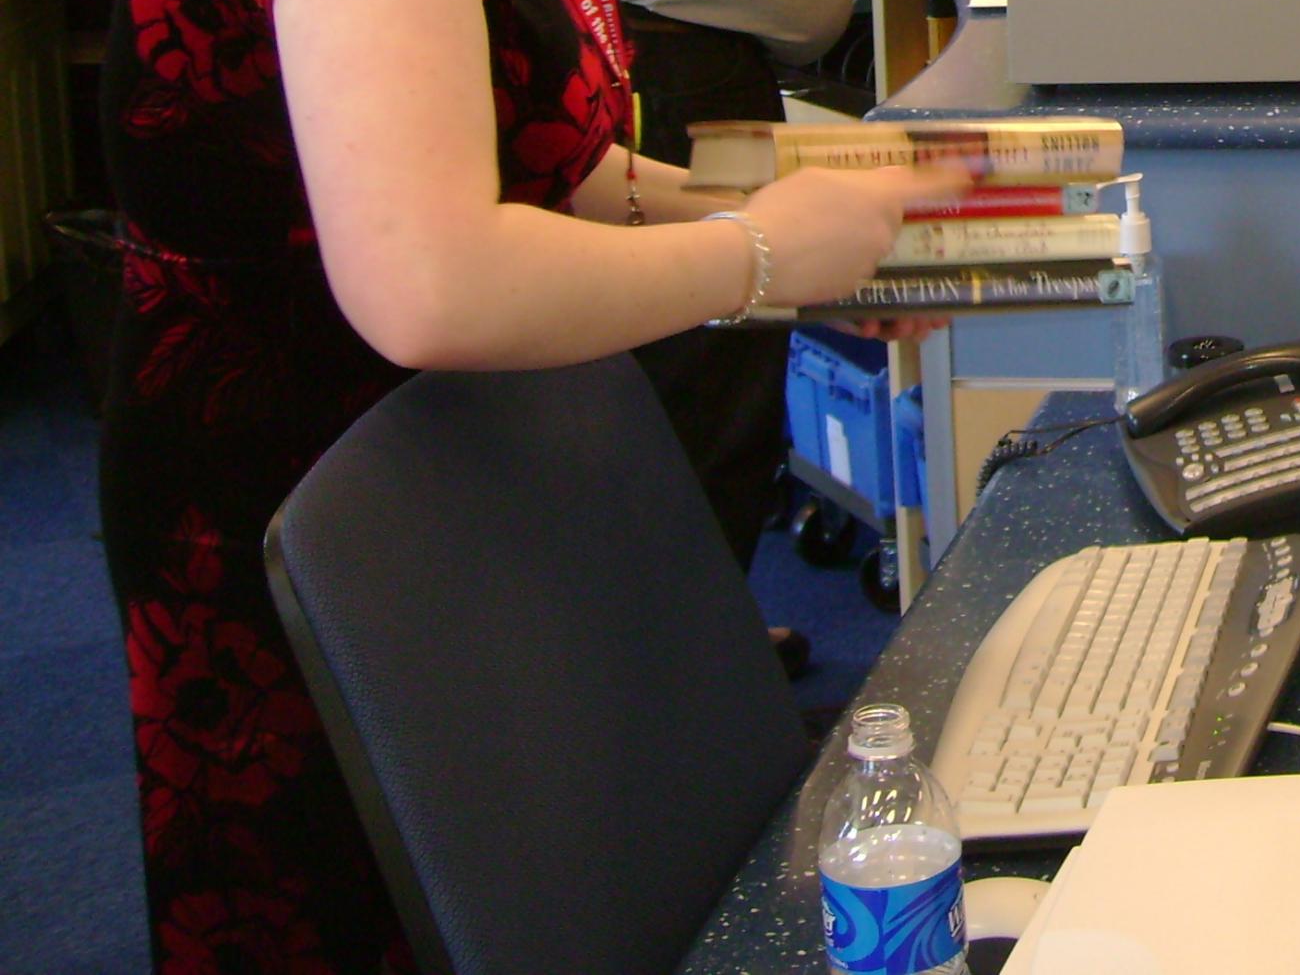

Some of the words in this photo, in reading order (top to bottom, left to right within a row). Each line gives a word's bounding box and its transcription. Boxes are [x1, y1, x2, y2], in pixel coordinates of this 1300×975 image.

[592, 16, 608, 44] the
[1040, 135, 1098, 150] ROLLINS
[827, 149, 908, 167] STRAIN
[856, 277, 961, 305] GRAFTON
